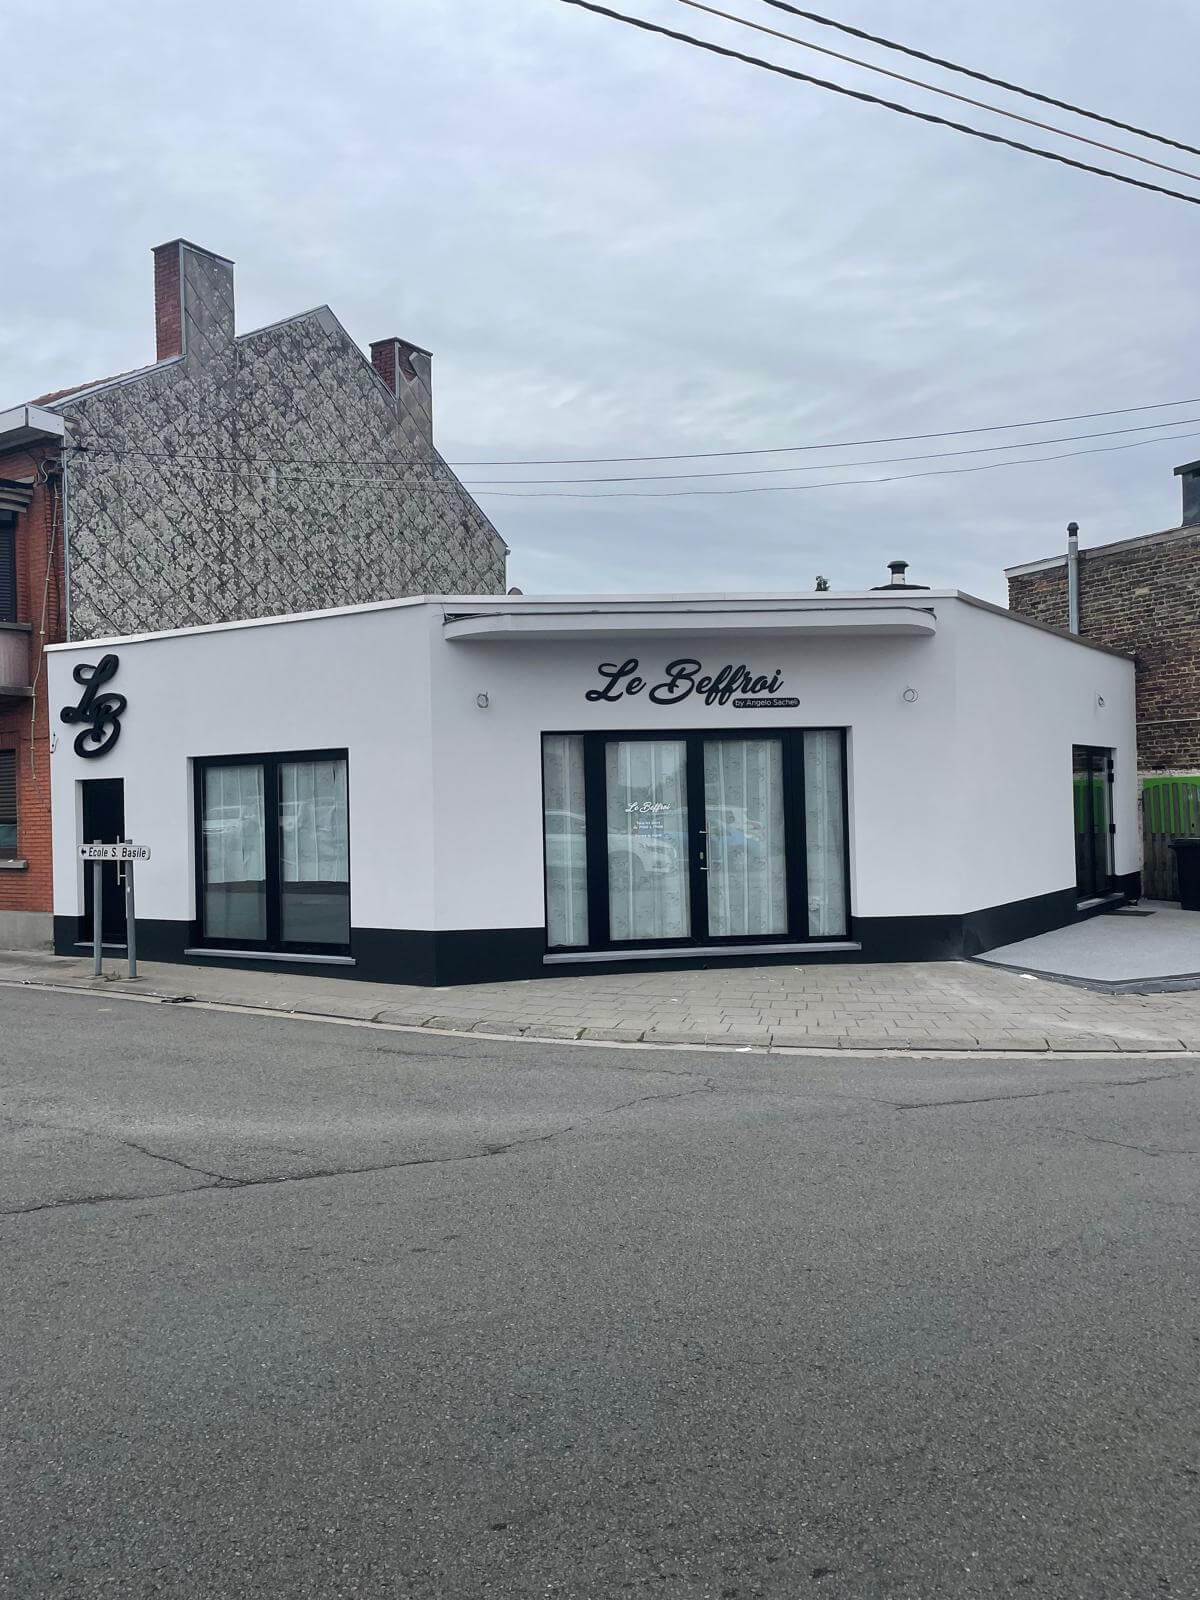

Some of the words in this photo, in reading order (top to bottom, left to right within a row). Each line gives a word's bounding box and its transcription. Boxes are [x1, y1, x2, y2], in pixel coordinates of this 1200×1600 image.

[585, 658, 647, 702] Le
[649, 658, 784, 706] Beffroi
[625, 801, 639, 812] Le
[640, 801, 671, 813] Beffroi
[121, 847, 147, 858] Basile
